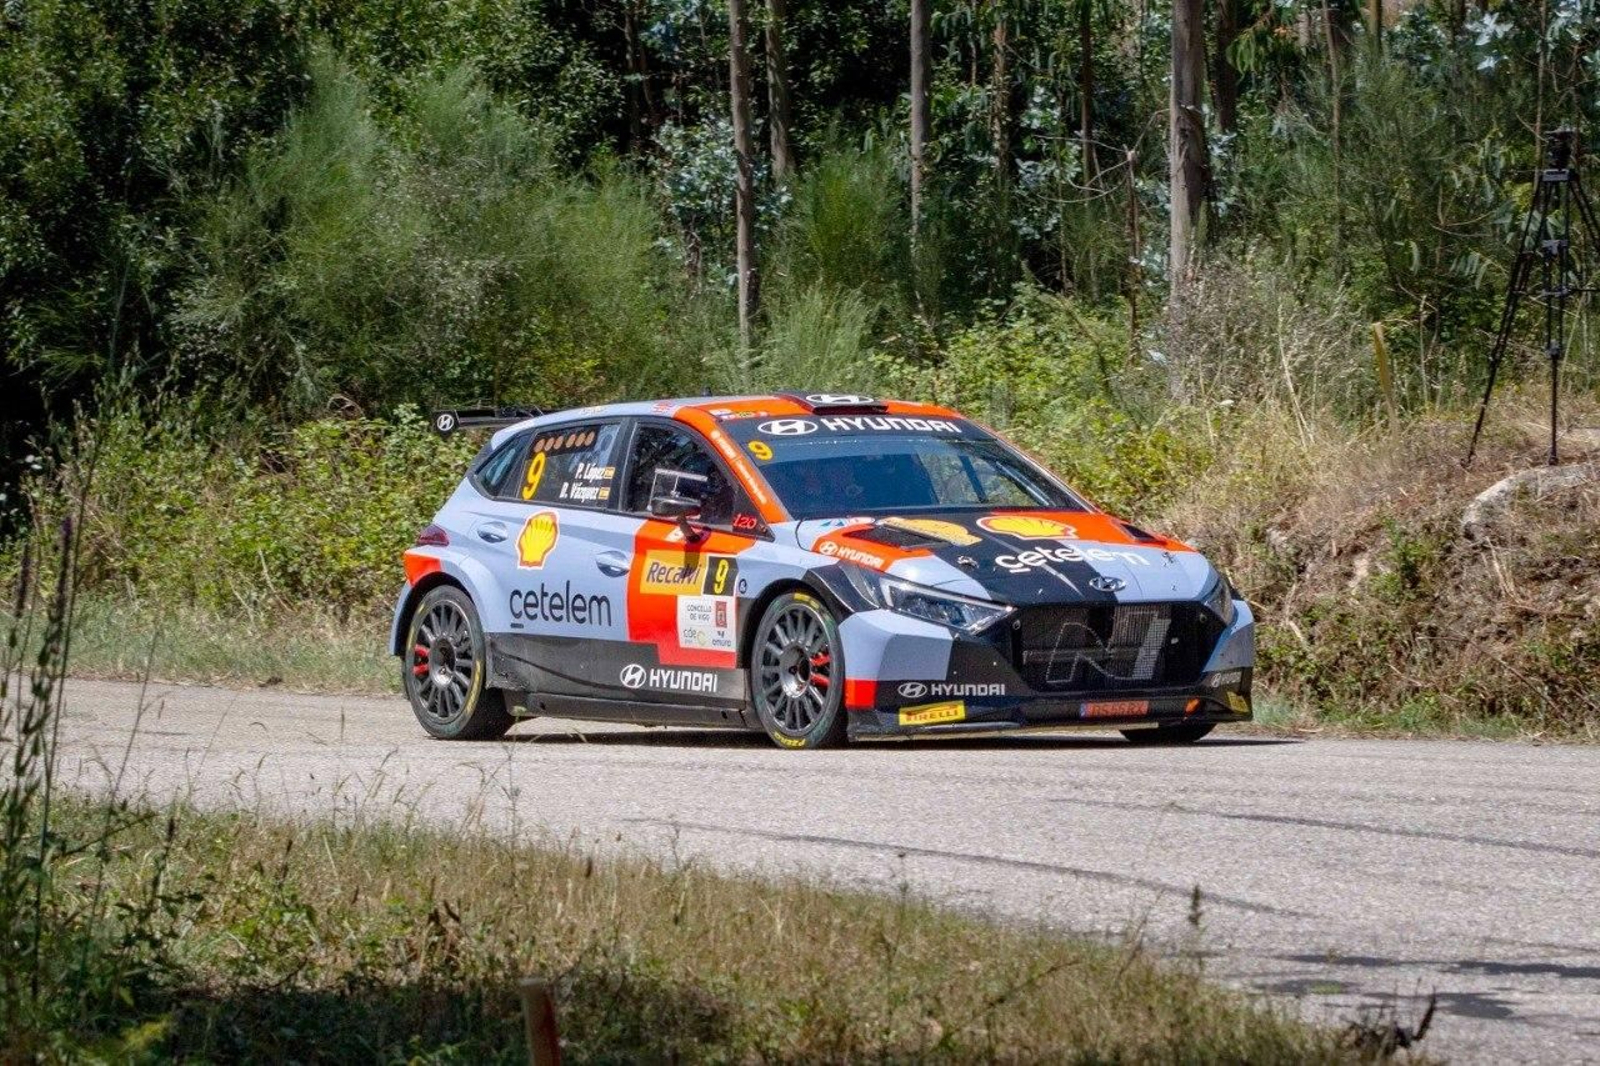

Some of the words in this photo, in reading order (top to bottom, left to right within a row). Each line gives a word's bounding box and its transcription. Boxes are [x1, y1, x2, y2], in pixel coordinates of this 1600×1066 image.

[820, 417, 963, 433] HYUNDAI
[748, 440, 774, 461] 9
[522, 451, 546, 500] 9
[838, 546, 885, 567] HYUNDAI
[995, 546, 1150, 574] cetelem
[714, 559, 729, 595] 9
[509, 580, 612, 628] cetelem
[649, 668, 718, 692] HYUNDAI
[930, 683, 1005, 696] HYUNDAI
[905, 703, 959, 722] PIRELLI
